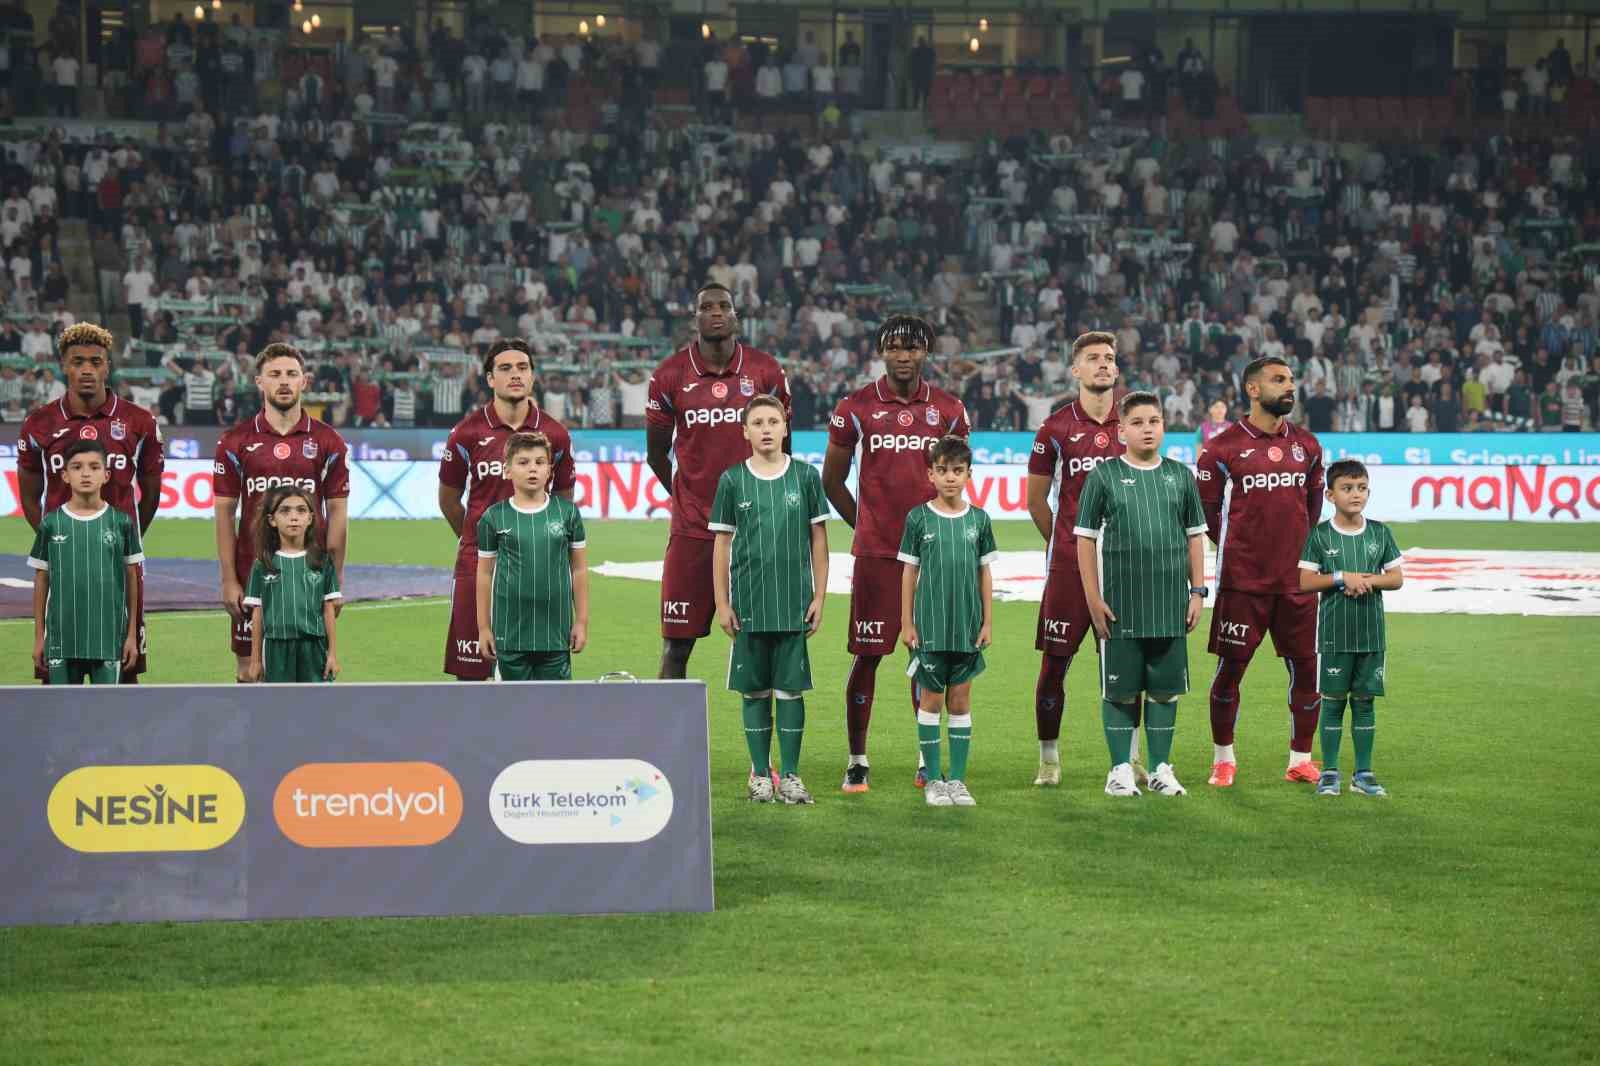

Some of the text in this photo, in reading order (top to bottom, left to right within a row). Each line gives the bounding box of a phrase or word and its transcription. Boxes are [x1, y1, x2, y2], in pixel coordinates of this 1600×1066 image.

[685, 408, 744, 428] papar
[51, 453, 127, 473] pra
[1242, 472, 1306, 494] papara
[663, 600, 690, 615] YKT
[855, 620, 885, 635] YKT
[1044, 617, 1071, 635] YKT
[1220, 620, 1250, 638] YKT
[292, 784, 446, 822] trendyol
[500, 791, 627, 809] Türk Telekom
